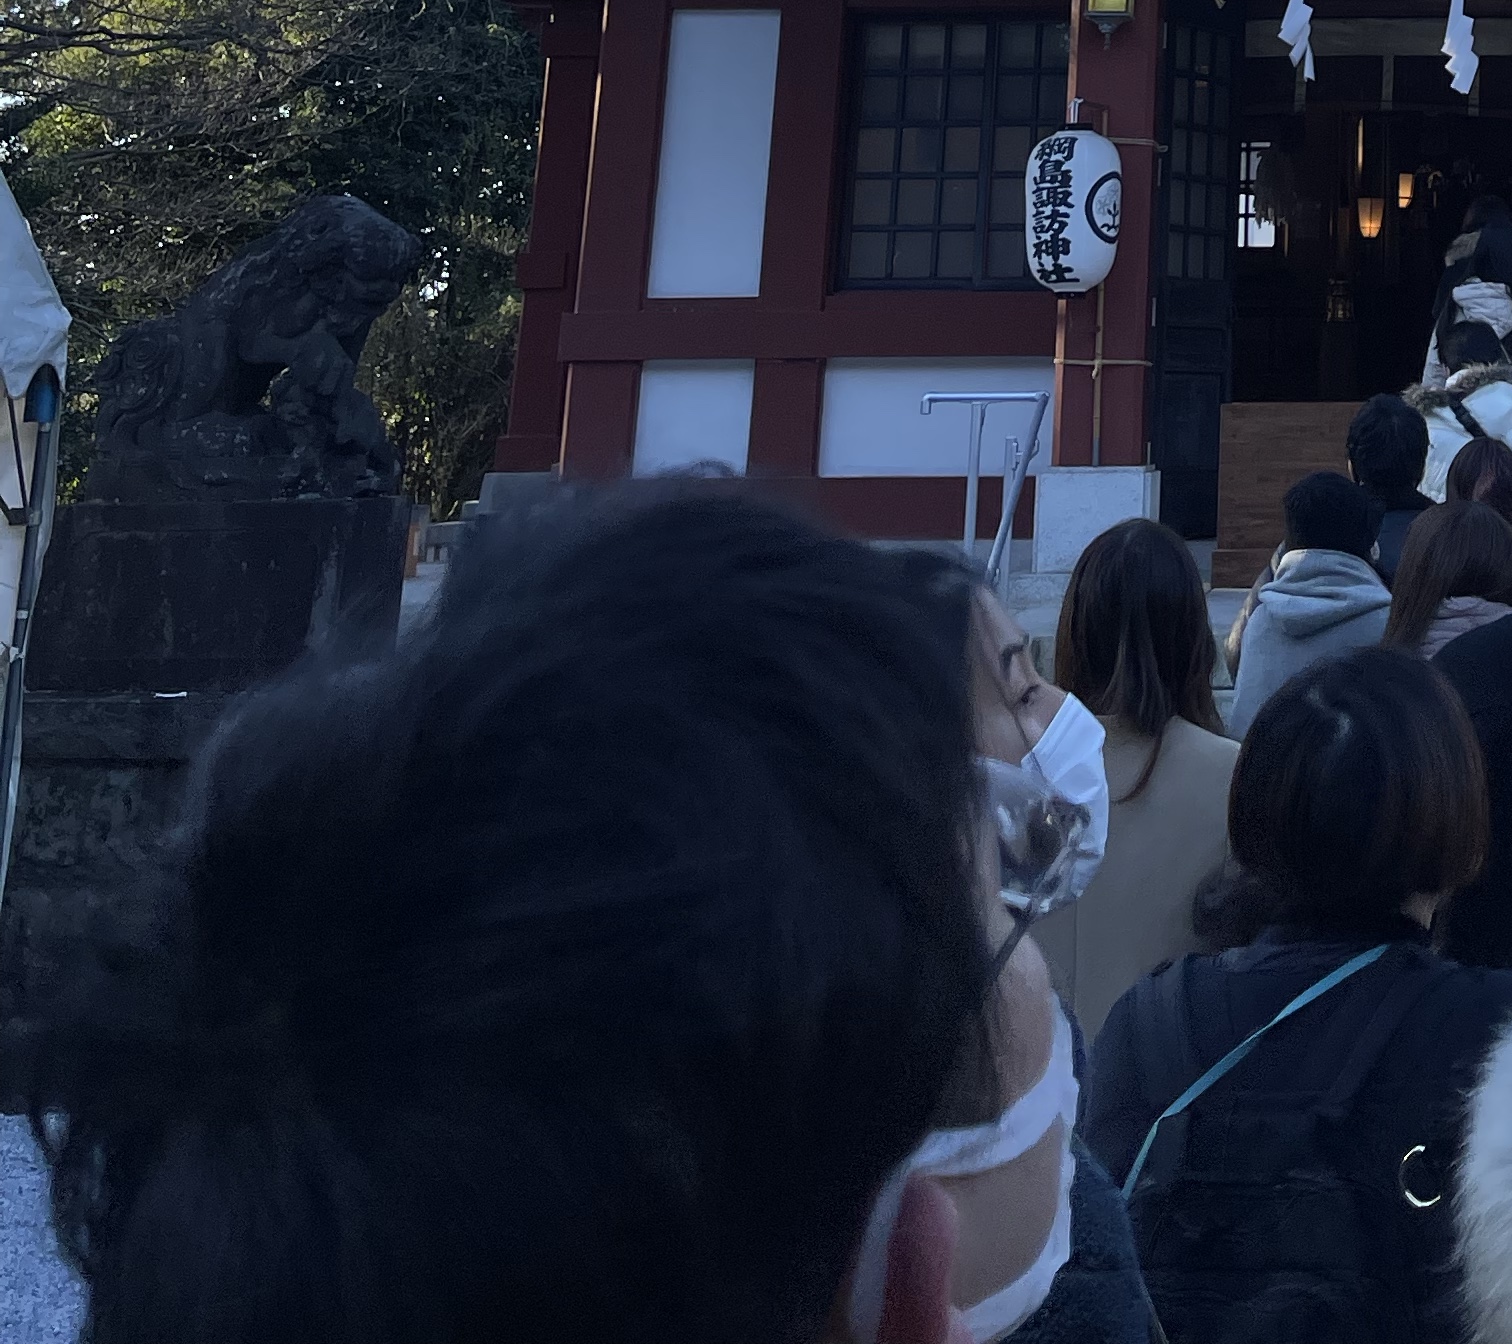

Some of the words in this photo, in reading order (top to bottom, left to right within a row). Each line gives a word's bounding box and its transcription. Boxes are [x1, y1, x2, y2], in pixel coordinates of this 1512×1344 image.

[1032, 136, 1080, 284] 綱島諏訪神社
